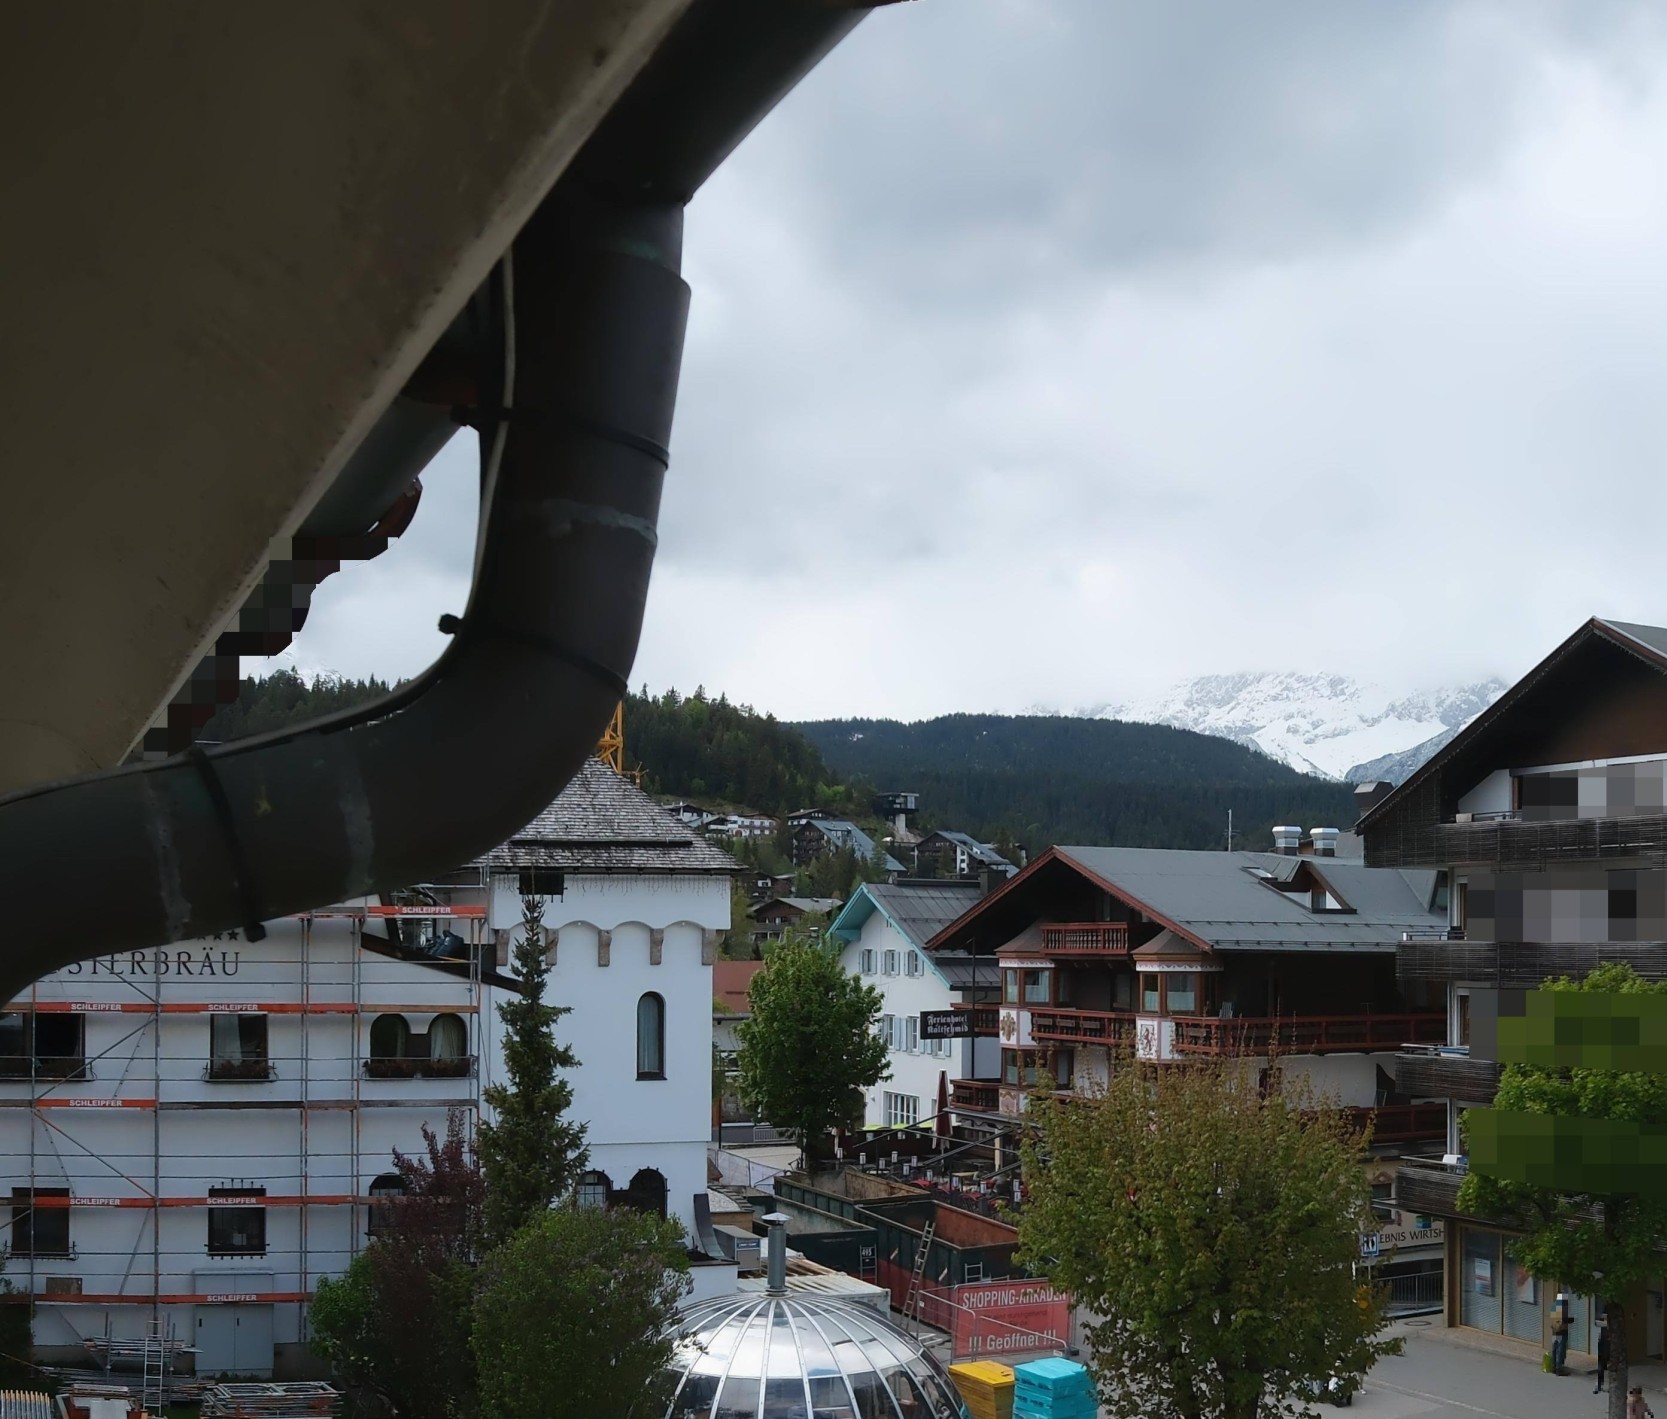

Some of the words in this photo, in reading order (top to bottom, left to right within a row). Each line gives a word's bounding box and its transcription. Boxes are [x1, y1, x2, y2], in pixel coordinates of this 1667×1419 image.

[401, 906, 452, 914] SCHLEIPFER
[49, 946, 241, 976] STERBRÄU
[70, 1003, 122, 1011] SCHLEIPFER
[207, 1003, 259, 1012] SCHLEIPFER
[69, 1099, 123, 1107] SCHLEIPFER
[69, 1198, 122, 1206] SCHLEIPFER
[206, 1197, 258, 1205] SCHLEIPFER
[206, 1294, 258, 1303] SCHLEIPFER
[969, 1336, 982, 1352] !!!
[986, 1330, 1041, 1351] Geöffnet
[1043, 1329, 1057, 1345] !!!
